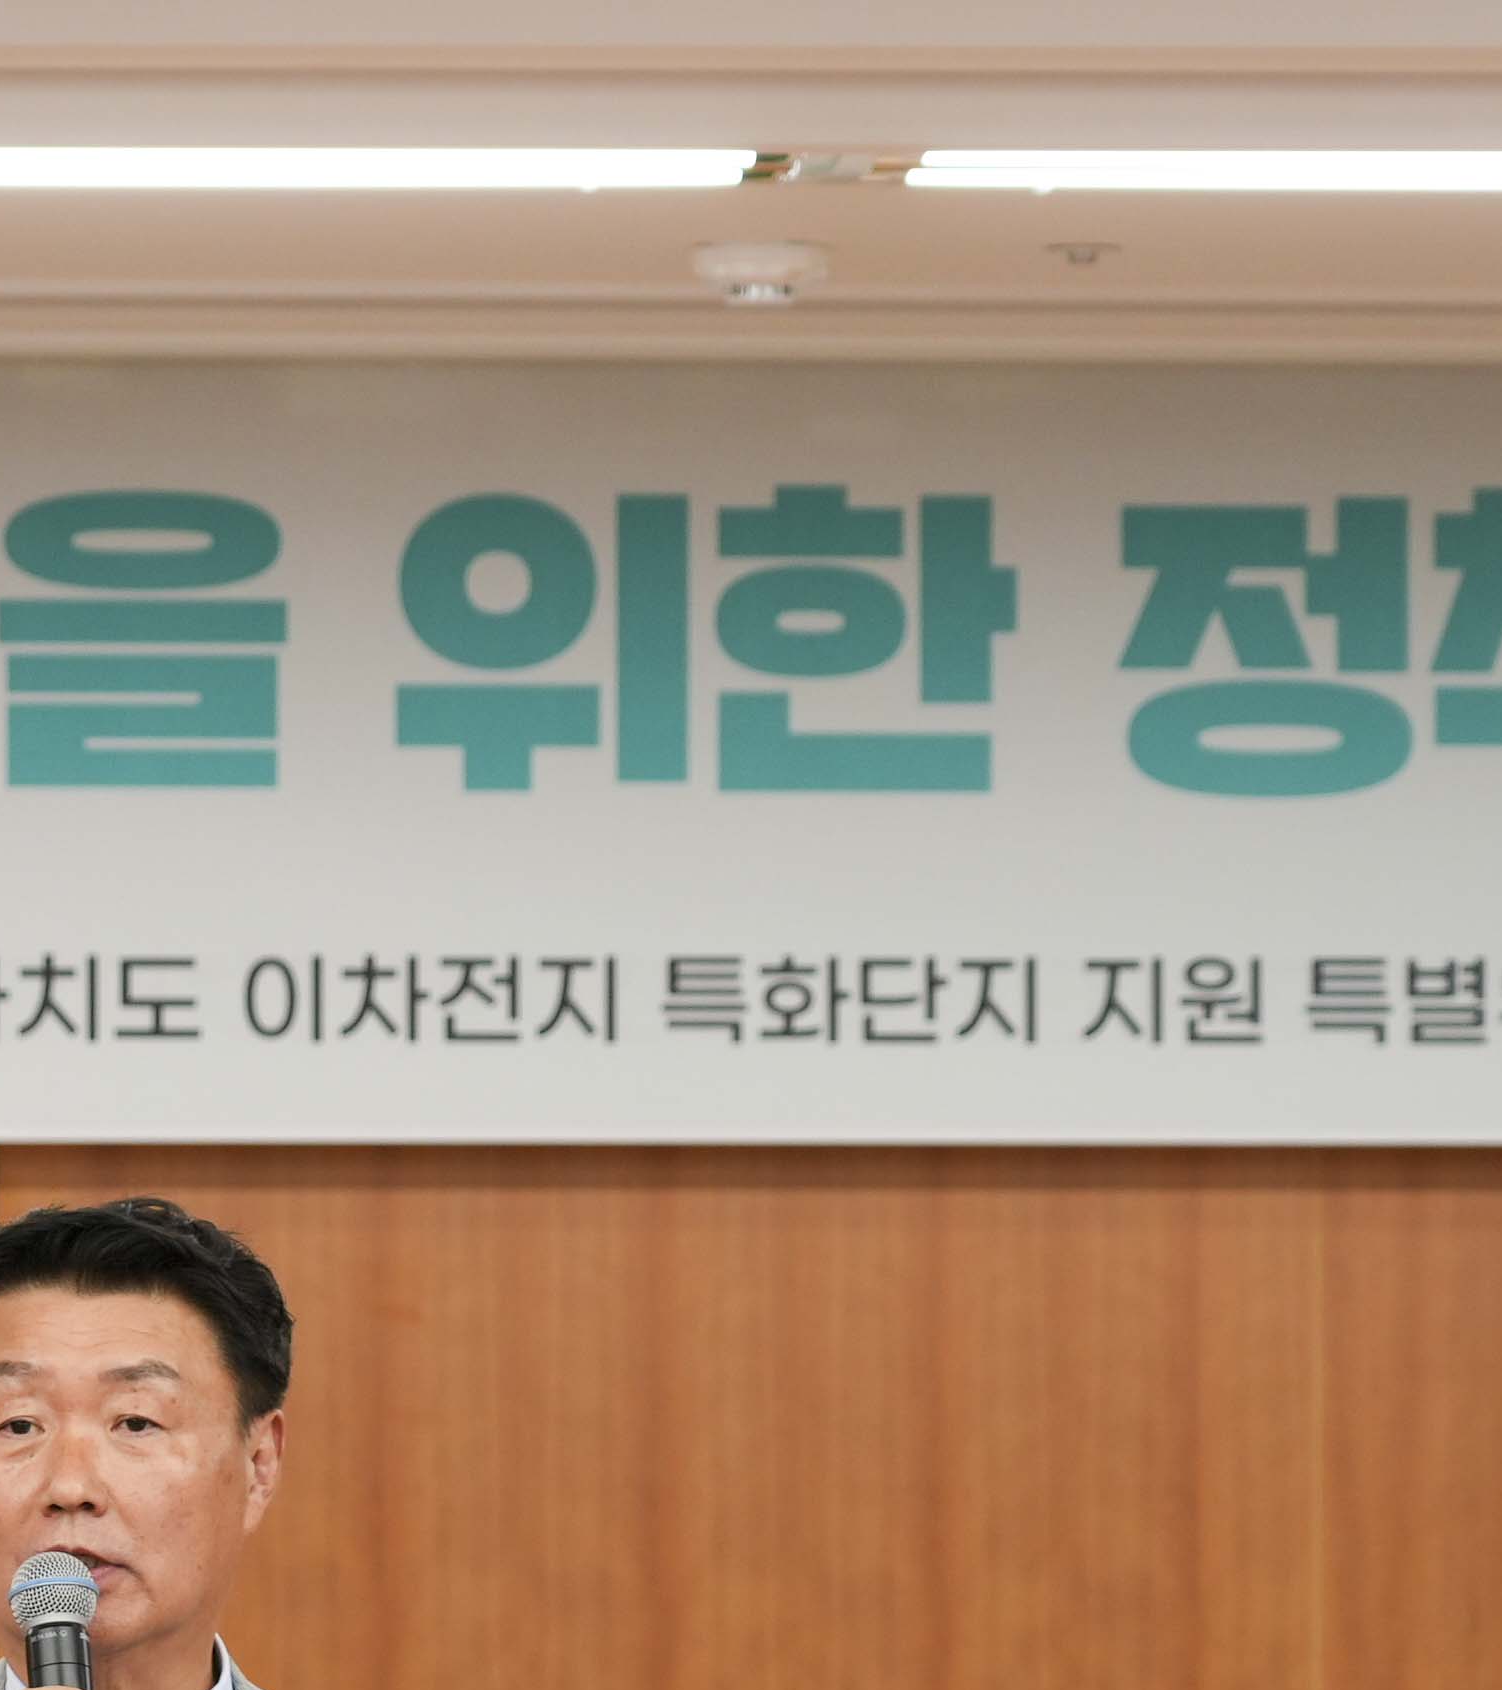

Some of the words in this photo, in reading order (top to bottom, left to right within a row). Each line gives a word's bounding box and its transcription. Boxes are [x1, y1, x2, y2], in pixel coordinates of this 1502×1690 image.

[392, 484, 1019, 796] 위한
[243, 954, 617, 1043] 이차전지
[661, 954, 1039, 1044] 특화단지
[1082, 954, 1264, 1044] 지원
